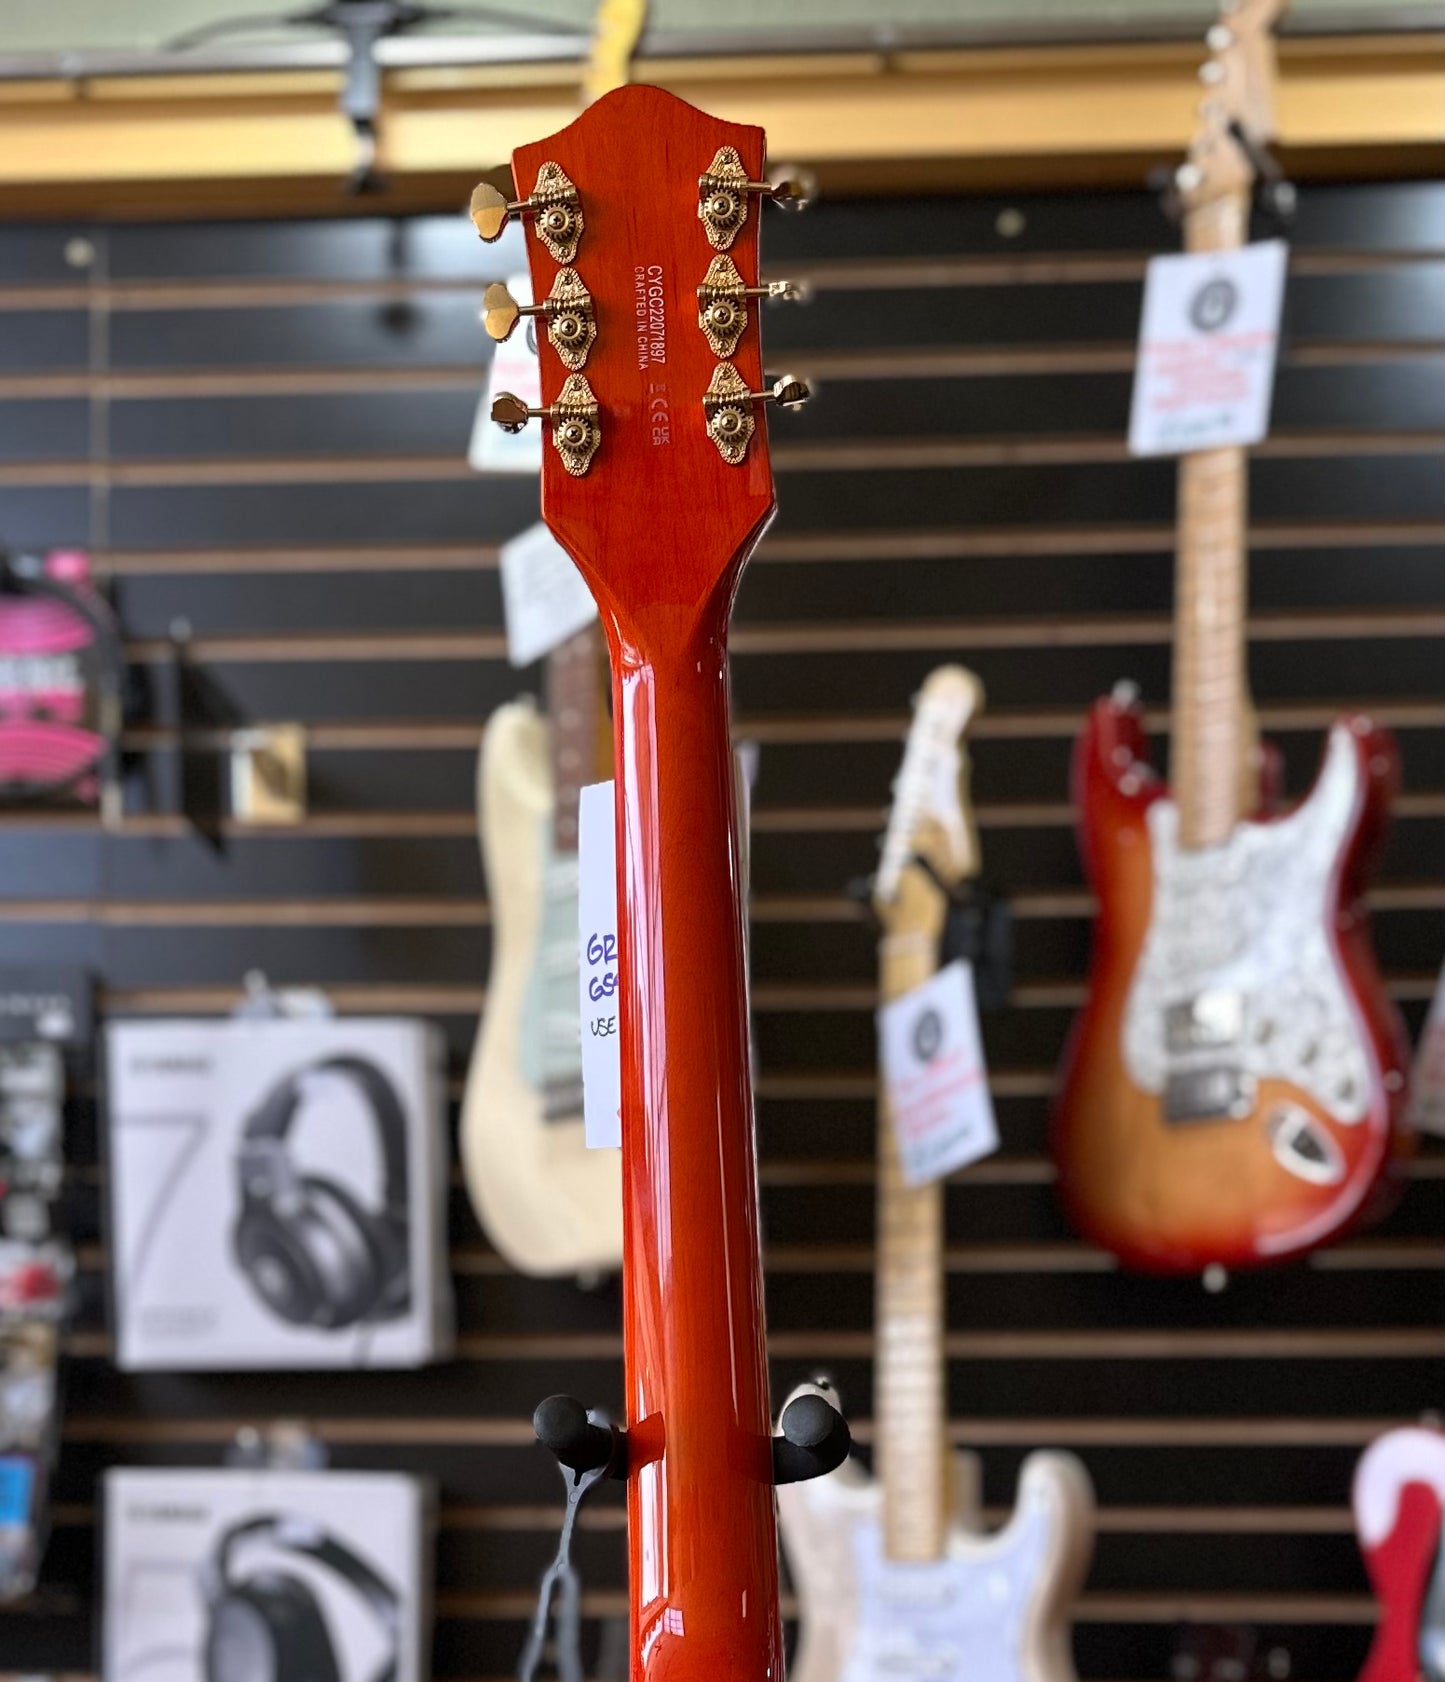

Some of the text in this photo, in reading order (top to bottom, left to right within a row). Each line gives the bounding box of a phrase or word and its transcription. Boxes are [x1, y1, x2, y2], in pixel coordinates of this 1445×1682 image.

[634, 266, 649, 371] CRAFTED IN CHINA
[647, 265, 666, 364] CYGC22071897
[651, 398, 669, 423] CE
